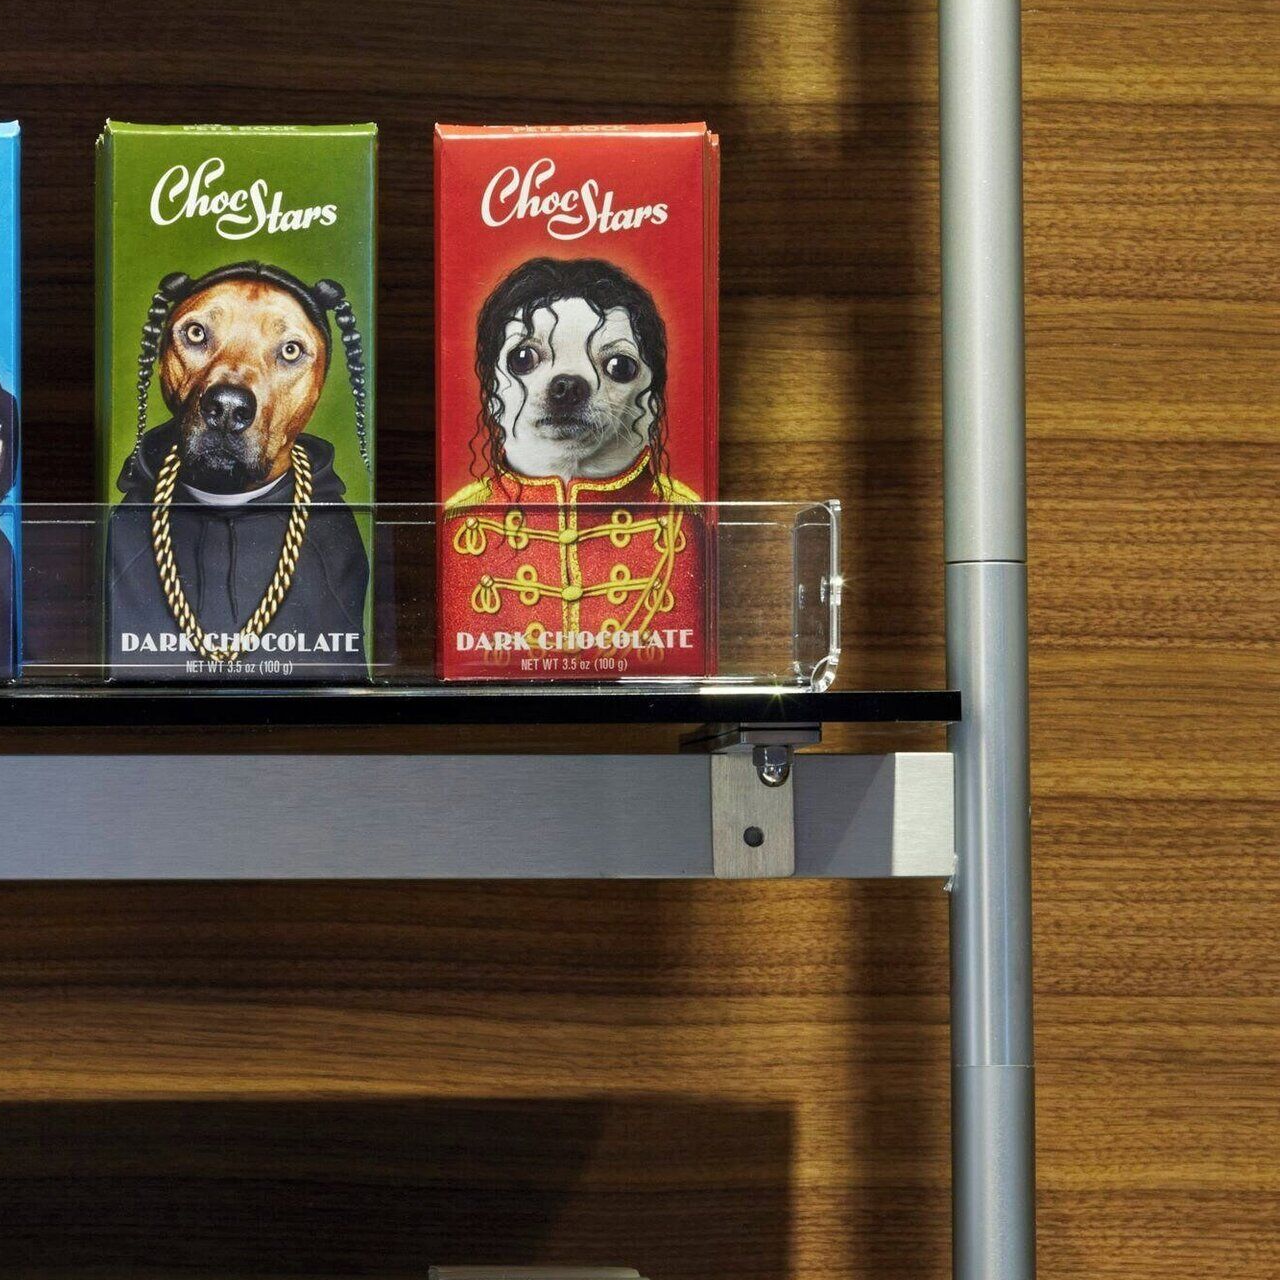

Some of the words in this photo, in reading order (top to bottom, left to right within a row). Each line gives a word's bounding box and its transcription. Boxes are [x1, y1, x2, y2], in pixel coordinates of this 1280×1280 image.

[122, 632, 196, 652] DARK
[203, 632, 359, 652] CHOCOLATE
[456, 631, 531, 651] DARK
[538, 629, 694, 650] CHOCOLATE
[187, 660, 204, 673] NET
[207, 660, 224, 673] WT
[227, 660, 243, 673] 3.5
[245, 663, 256, 673] oz
[259, 660, 279, 675] (100
[521, 658, 538, 671] NET
[543, 658, 558, 670] WT
[562, 658, 578, 670] 3.5
[580, 660, 590, 670] oz
[594, 658, 615, 672] (100
[617, 658, 628, 672] g)
